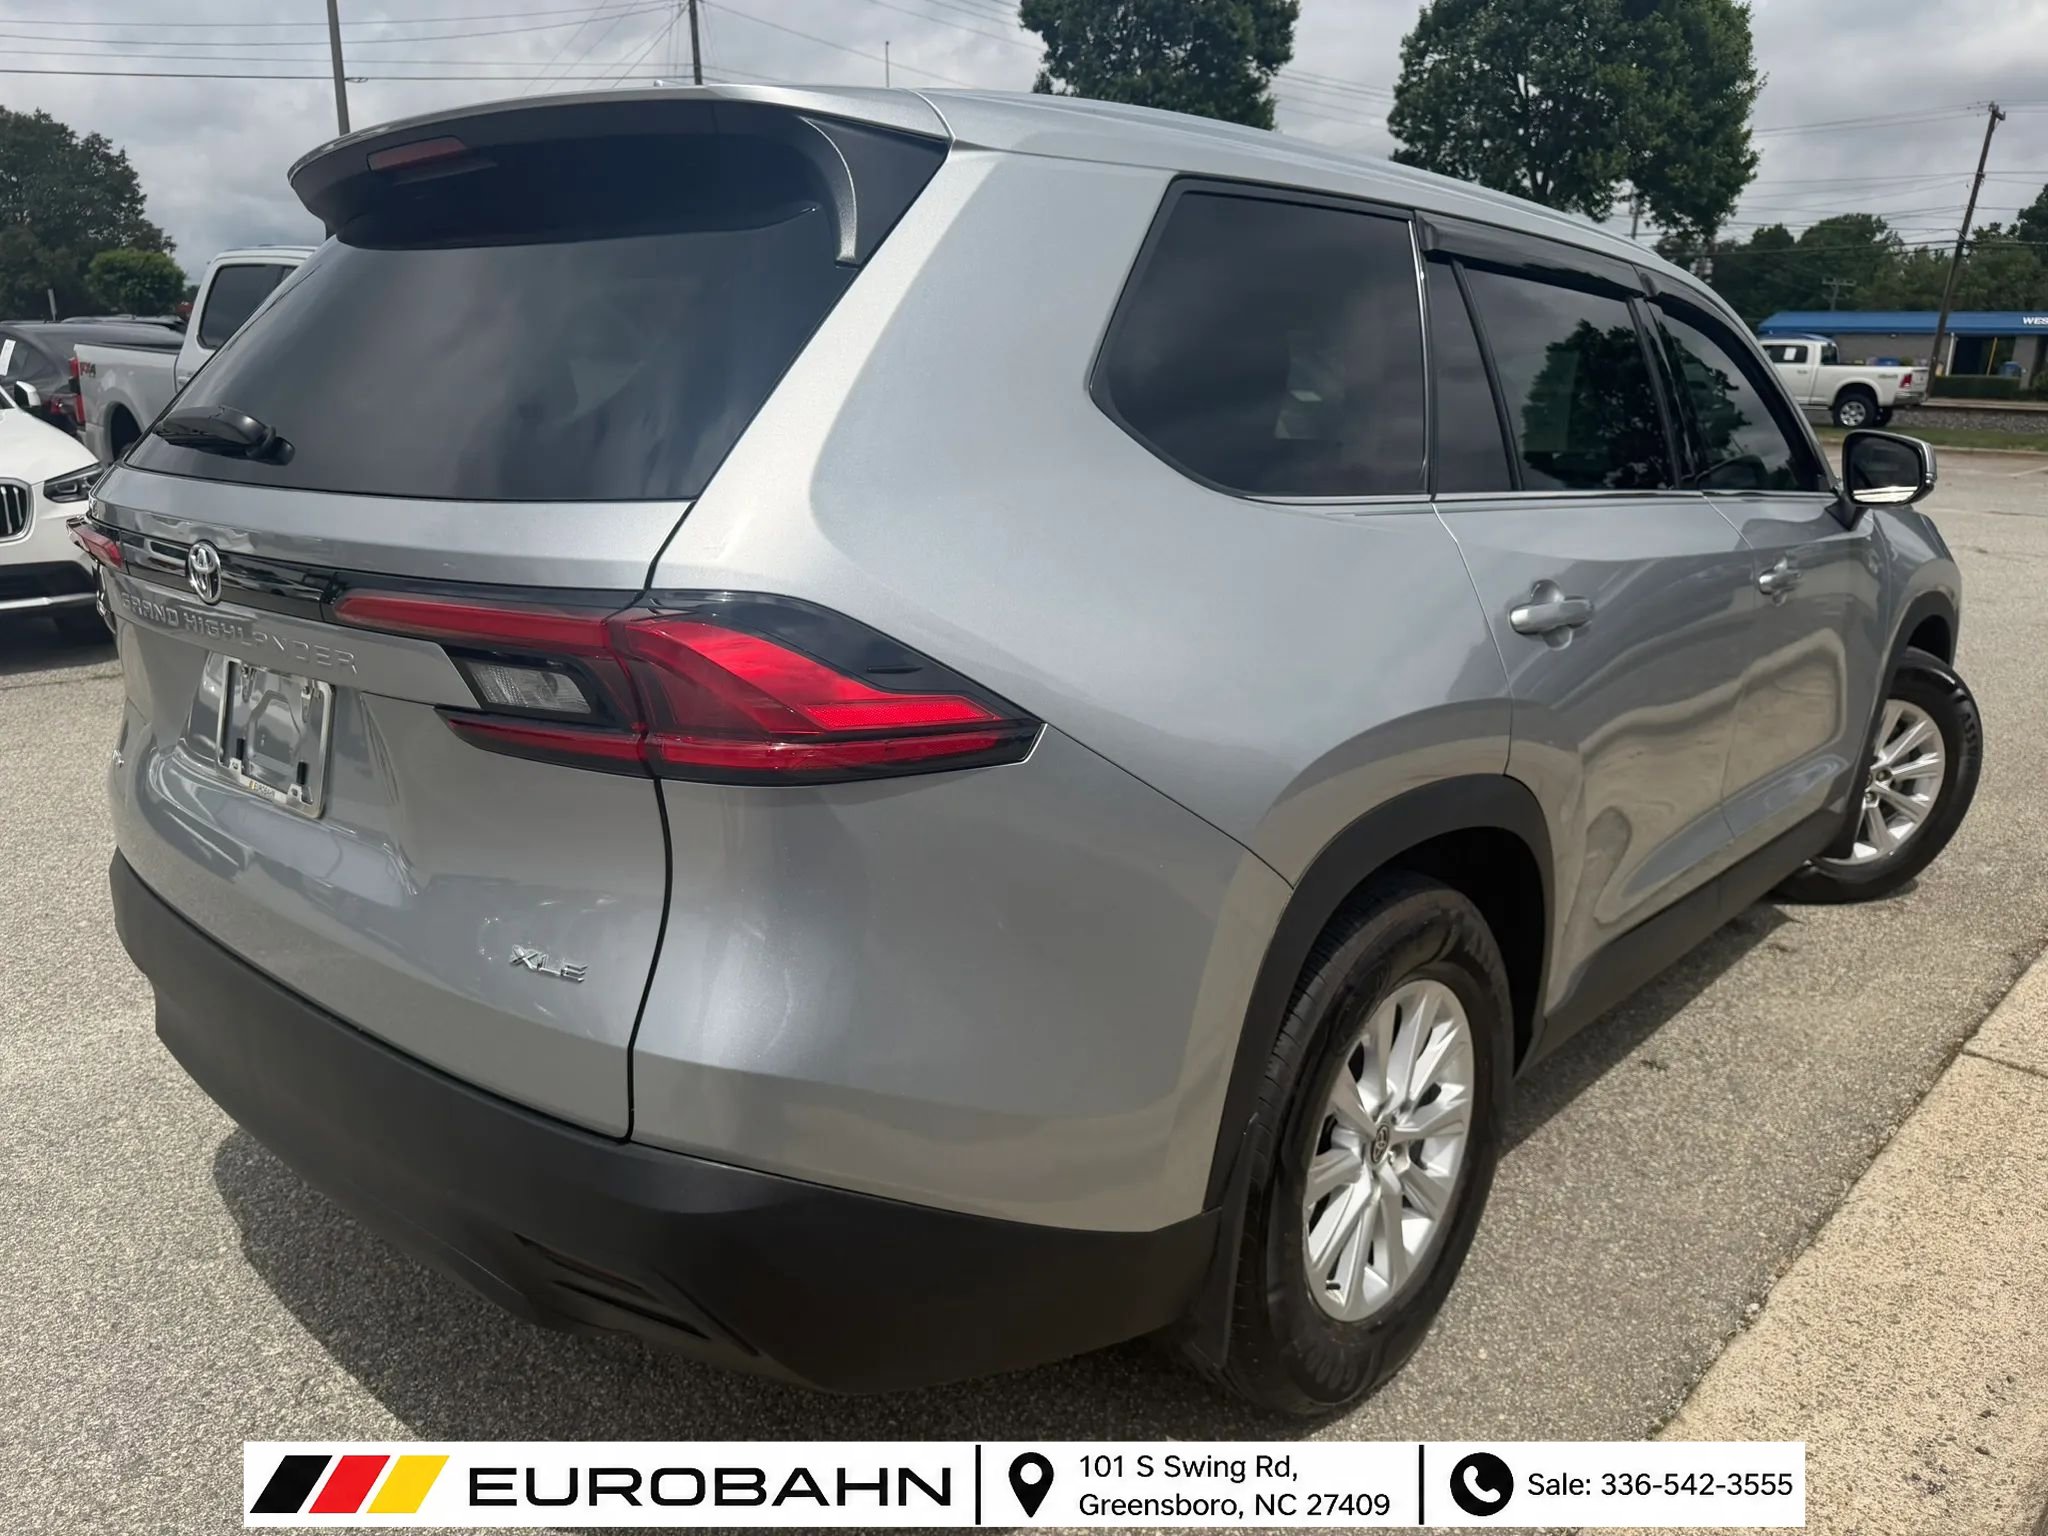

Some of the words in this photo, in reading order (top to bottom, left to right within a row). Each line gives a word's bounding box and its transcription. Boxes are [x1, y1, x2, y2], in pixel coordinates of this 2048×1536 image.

[121, 592, 179, 627] GRAND
[184, 611, 358, 675] HIGHLANDER
[509, 945, 588, 983] XLE
